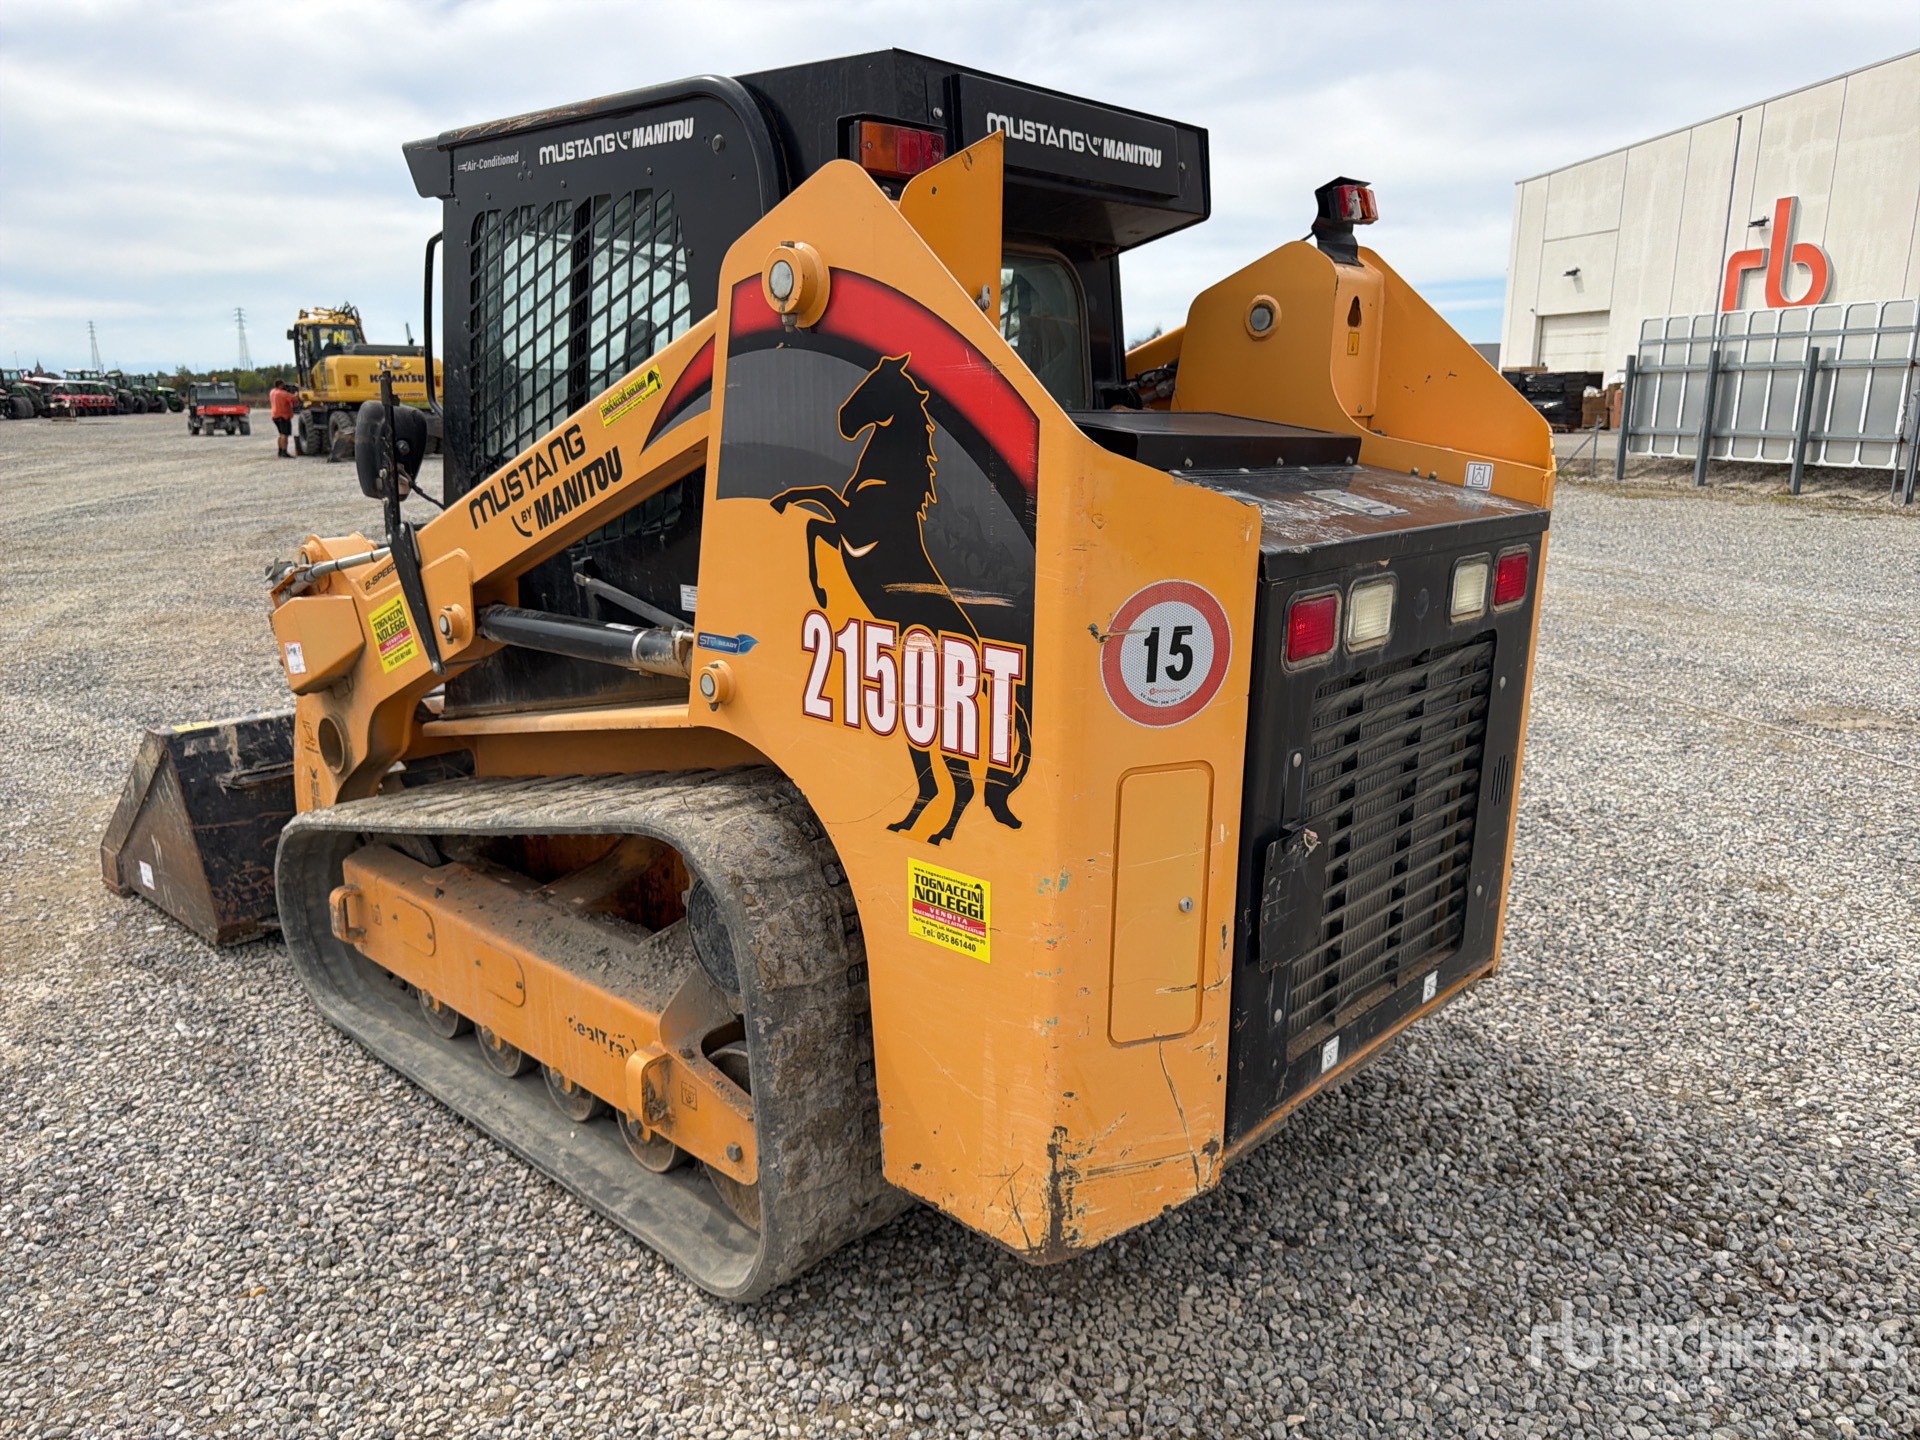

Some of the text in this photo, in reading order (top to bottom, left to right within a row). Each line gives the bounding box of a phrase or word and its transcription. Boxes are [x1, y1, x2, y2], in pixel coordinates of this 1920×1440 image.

[467, 151, 520, 172] Air-Conditioned
[539, 117, 695, 166] MUSTANG BY MANITOU
[986, 112, 1163, 169] MUSTANG BY MANITOU
[1721, 196, 1833, 312] rb
[469, 423, 586, 530] MUSTANG
[521, 445, 623, 531] BY MANITOU
[376, 616, 408, 642] NOLEGGI
[1144, 626, 1193, 684] 15
[801, 608, 1024, 769] 2150RT
[914, 885, 984, 921] NOLEGGI
[929, 907, 969, 925] VENDITA
[936, 931, 950, 943] 055
[950, 936, 977, 953] 861440
